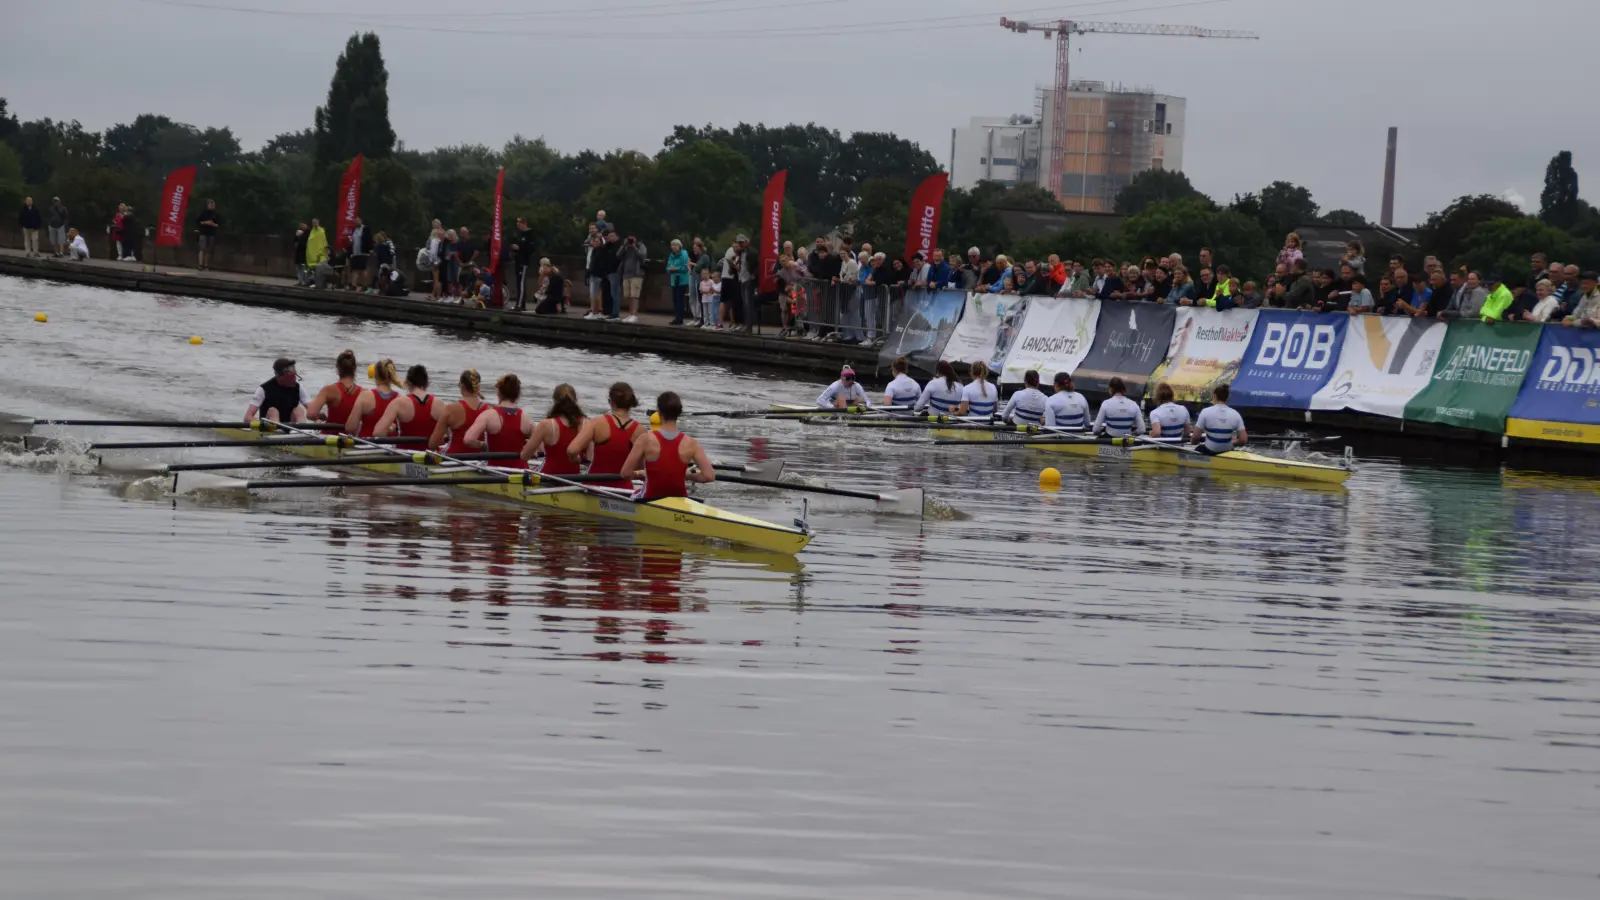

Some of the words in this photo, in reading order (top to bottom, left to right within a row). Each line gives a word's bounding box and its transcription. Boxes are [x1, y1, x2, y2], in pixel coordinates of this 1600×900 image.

[170, 185, 184, 222] Melitta
[1021, 335, 1079, 356] LANDSCHÄTZE
[1254, 322, 1336, 370] BOB
[1247, 369, 1273, 379] BAUEN
[1288, 372, 1323, 383] BESTAND
[1536, 381, 1600, 394] ZWEIRAD-CE
